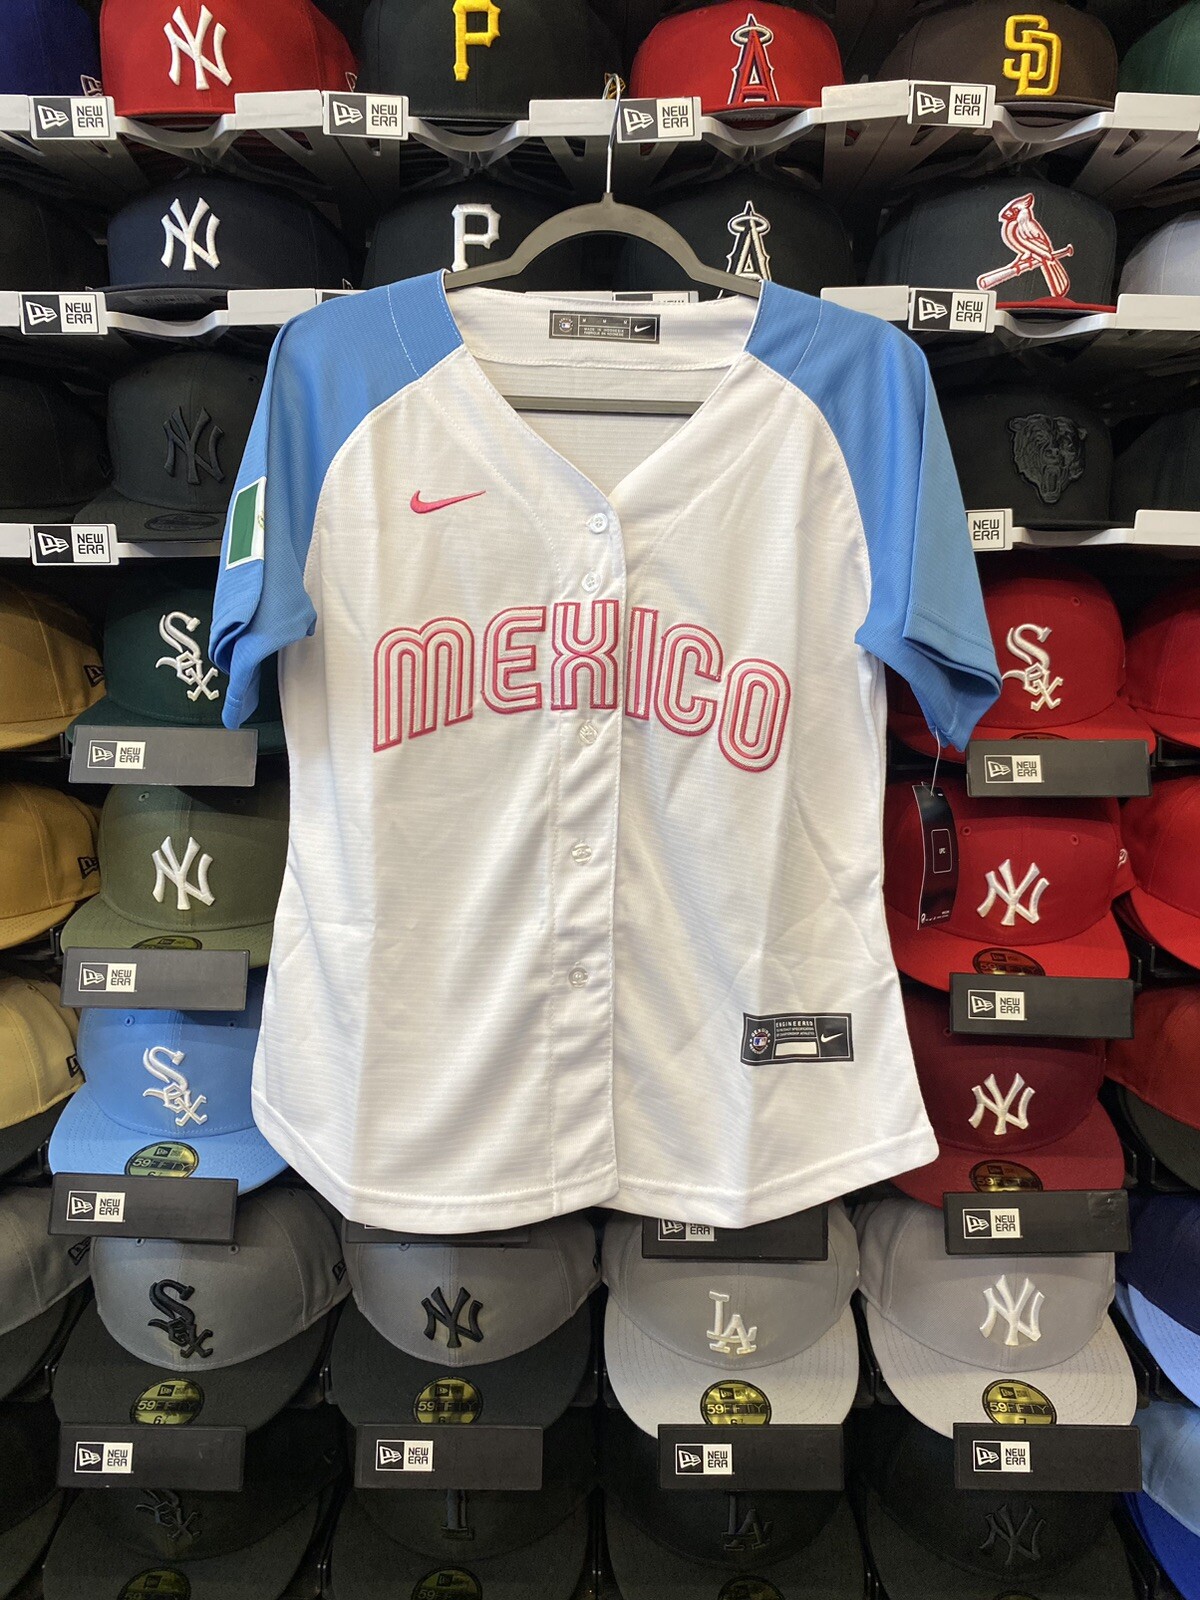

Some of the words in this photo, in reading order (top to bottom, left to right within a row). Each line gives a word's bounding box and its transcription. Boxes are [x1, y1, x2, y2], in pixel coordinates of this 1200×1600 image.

[453, 0, 501, 81] P
[163, 4, 233, 90] NY
[1003, 14, 1062, 96] SD
[955, 93, 981, 105] NEW
[76, 105, 103, 116] NEW
[371, 103, 397, 115] NEW
[662, 106, 688, 117] NEW
[954, 105, 980, 117] ERA
[78, 116, 104, 128] ERA
[371, 115, 398, 127] ERA
[662, 117, 689, 129] ERA
[160, 197, 220, 271] NY
[452, 203, 501, 272] P
[64, 302, 91, 313] NEW
[956, 301, 983, 312] NEW
[66, 313, 92, 325] ERA
[955, 312, 982, 323] ERA
[162, 406, 225, 485] NY
[973, 519, 1000, 530] NEW
[77, 534, 103, 544] NEW
[973, 530, 1000, 541] ERA
[78, 544, 105, 555] ERA
[373, 599, 791, 773] MEXICO
[119, 746, 141, 755] NEW
[118, 755, 140, 764] ERA
[1016, 761, 1037, 769] NEW
[1017, 769, 1038, 778] ERA
[151, 836, 216, 910] NY
[977, 859, 1050, 927] NY
[110, 969, 132, 978] NEW
[110, 978, 132, 986] ERA
[999, 996, 1021, 1006] NEW
[999, 1006, 1021, 1014] ERA
[968, 1073, 1035, 1135] NY
[99, 1198, 121, 1207] NEW
[98, 1206, 121, 1216] ERA
[995, 1214, 1016, 1223] NEW
[689, 1226, 711, 1236] ERA
[995, 1222, 1017, 1232] ERA
[979, 1274, 1045, 1346] NY
[420, 1286, 484, 1348] NY
[706, 1290, 758, 1356] LA
[107, 1449, 129, 1458] NEW
[408, 1446, 429, 1455] NEW
[707, 1450, 728, 1459] NEW
[1005, 1447, 1026, 1456] NEW
[106, 1458, 128, 1467] ERA
[407, 1455, 429, 1465] ERA
[707, 1459, 729, 1469] ERA
[1005, 1456, 1027, 1466] ERA
